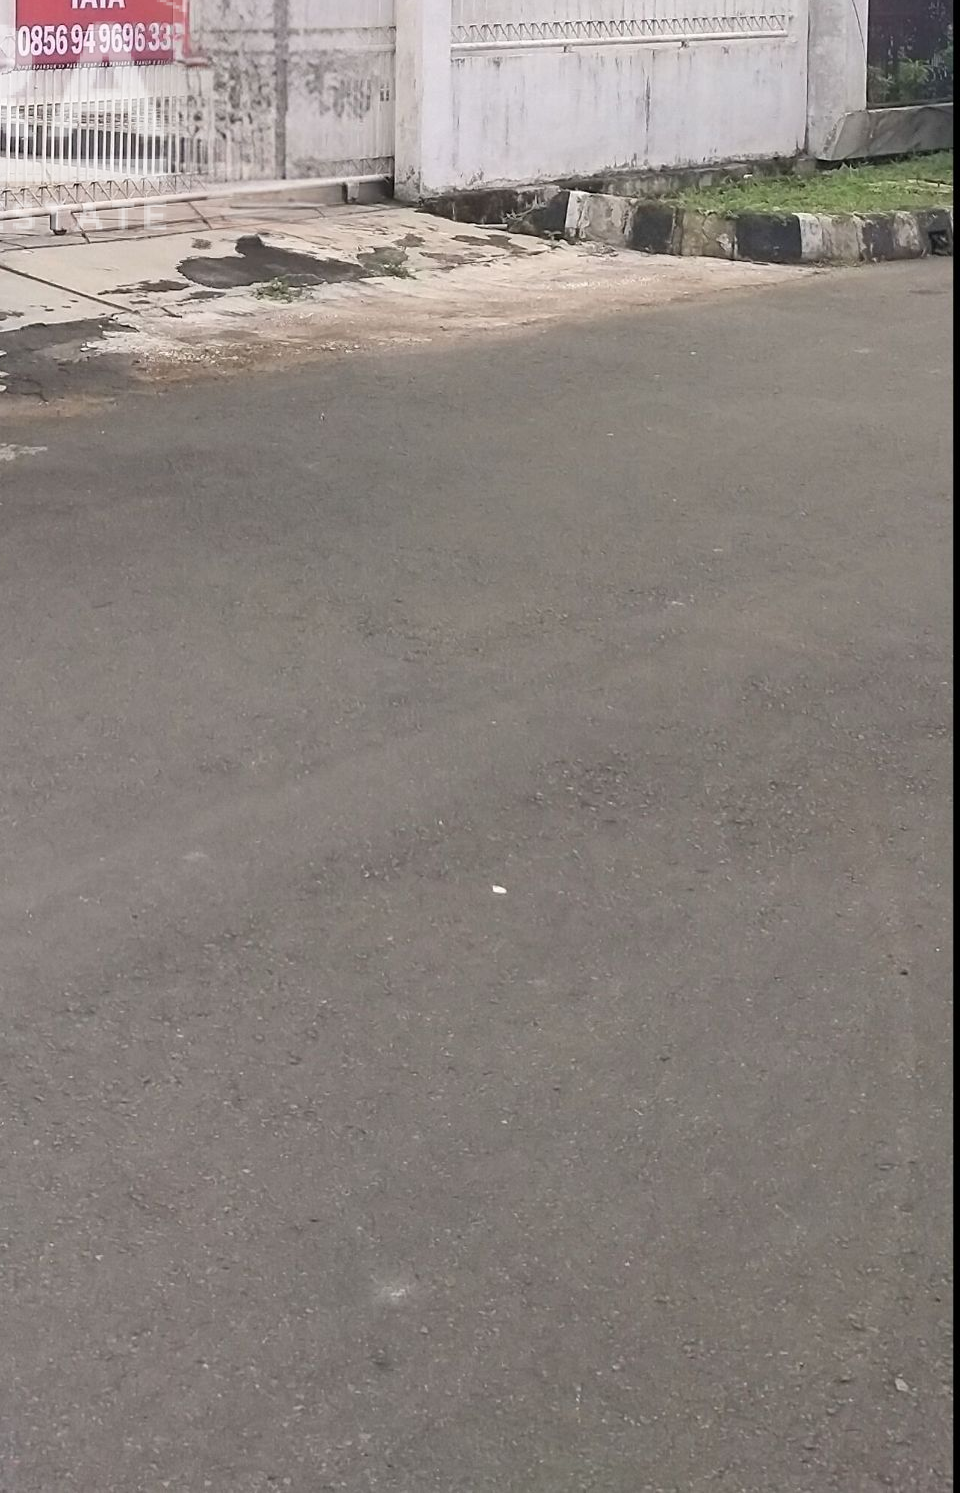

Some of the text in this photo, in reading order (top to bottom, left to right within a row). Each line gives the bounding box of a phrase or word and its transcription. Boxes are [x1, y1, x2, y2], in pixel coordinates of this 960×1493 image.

[17, 24, 68, 57] 0856
[71, 22, 96, 54] 94
[98, 22, 146, 53] 9696
